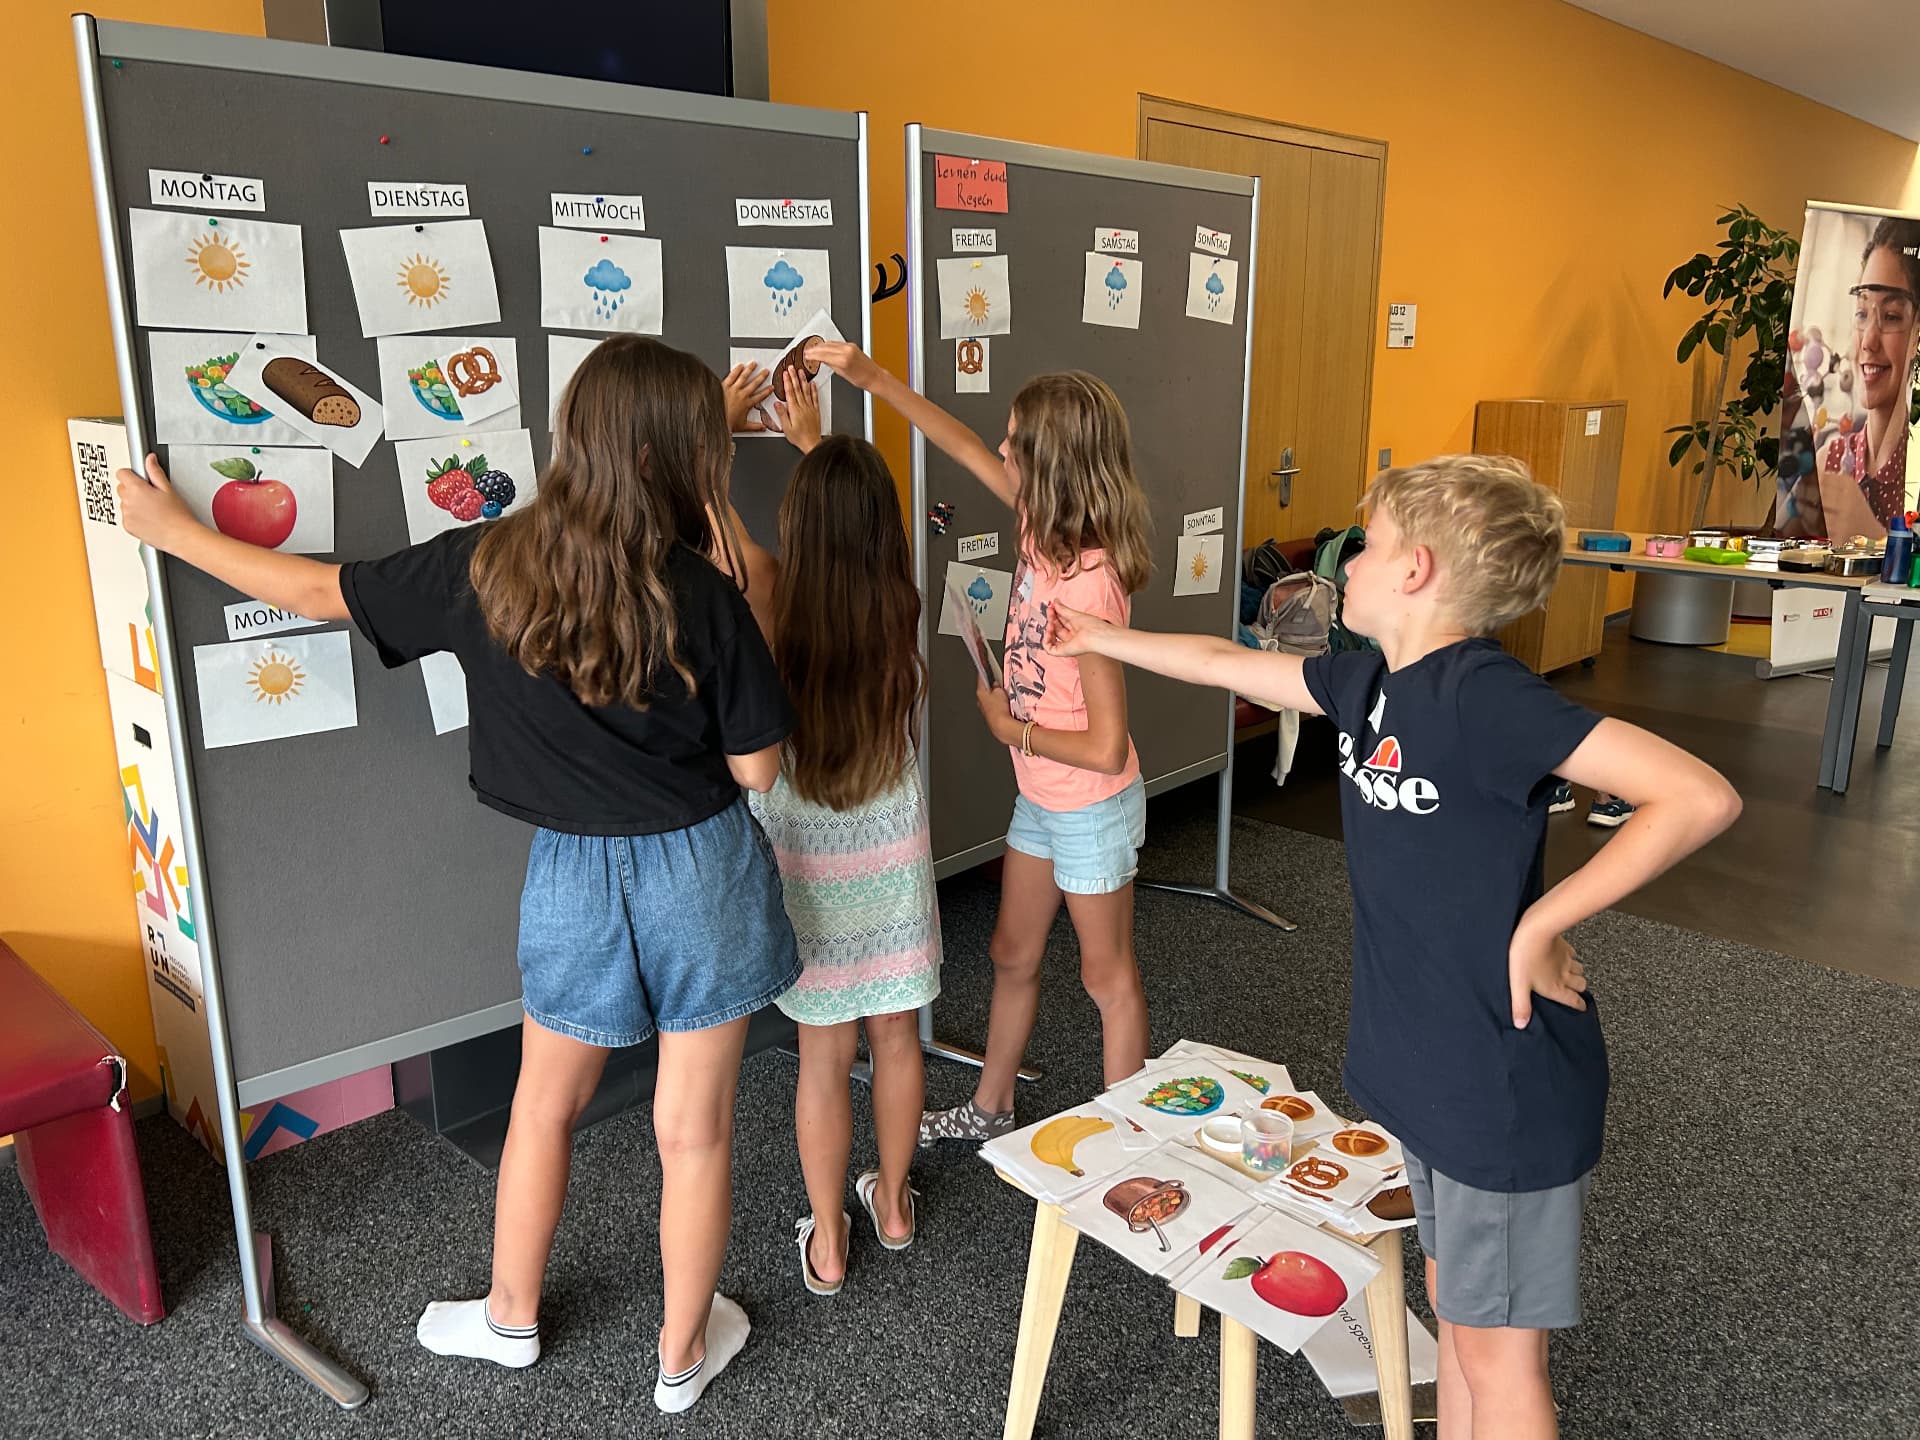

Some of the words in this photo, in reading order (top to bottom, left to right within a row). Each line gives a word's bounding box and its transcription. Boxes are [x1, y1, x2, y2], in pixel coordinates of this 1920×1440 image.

[160, 178, 257, 202] MONTAG
[374, 189, 465, 208] DIENSTAG
[554, 201, 641, 221] MITTWOCH
[739, 204, 829, 220] DONNERSTAG
[955, 233, 993, 247] FREITAG
[1101, 236, 1136, 250] SAMSTAG
[1197, 231, 1228, 251] SONNTAG
[1187, 513, 1216, 530] SONNTAG
[960, 536, 996, 554] FREITAG
